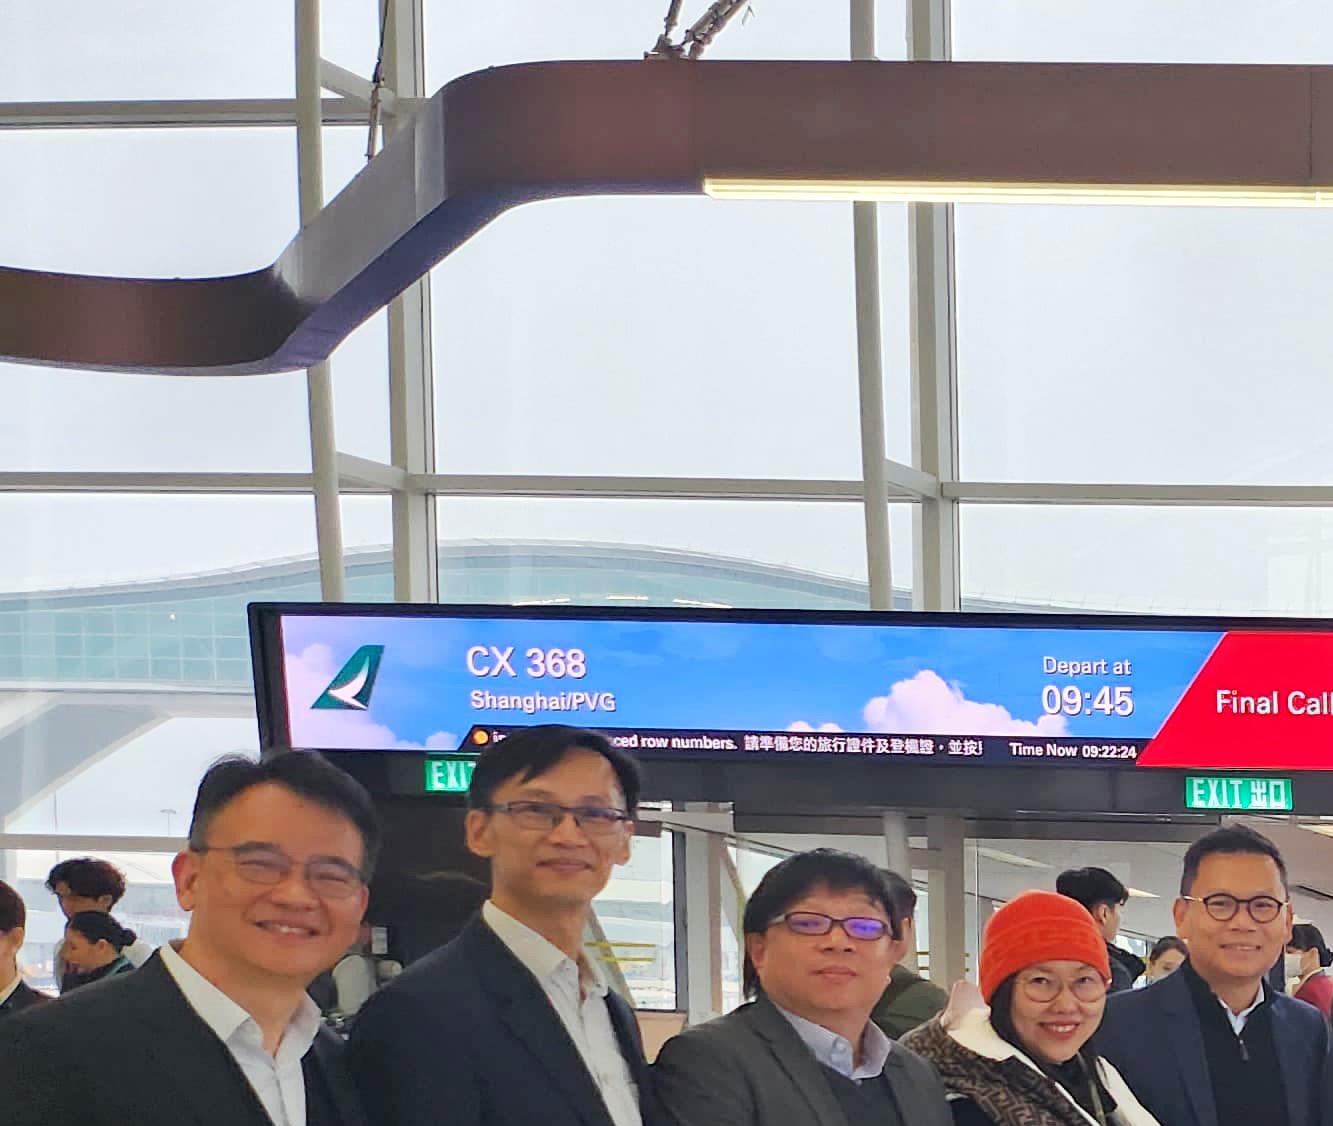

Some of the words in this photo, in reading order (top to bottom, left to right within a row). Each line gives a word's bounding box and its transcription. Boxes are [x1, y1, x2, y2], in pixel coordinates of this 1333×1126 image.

[466, 645, 517, 678] CX
[525, 647, 587, 680] 368
[1042, 655, 1109, 678] Depart
[1112, 658, 1133, 677] at
[470, 689, 617, 715] Shanghai/PVG
[1041, 684, 1135, 718] 09:45
[1215, 689, 1280, 715] Final
[609, 734, 638, 748] ced
[641, 736, 670, 748] row
[671, 734, 738, 750] numbers.
[1009, 742, 1044, 757] Time
[1046, 743, 1078, 758] Now
[1082, 745, 1138, 759] 09:22:24
[1191, 778, 1244, 809] EXIT
[1249, 779, 1287, 810] 出口
